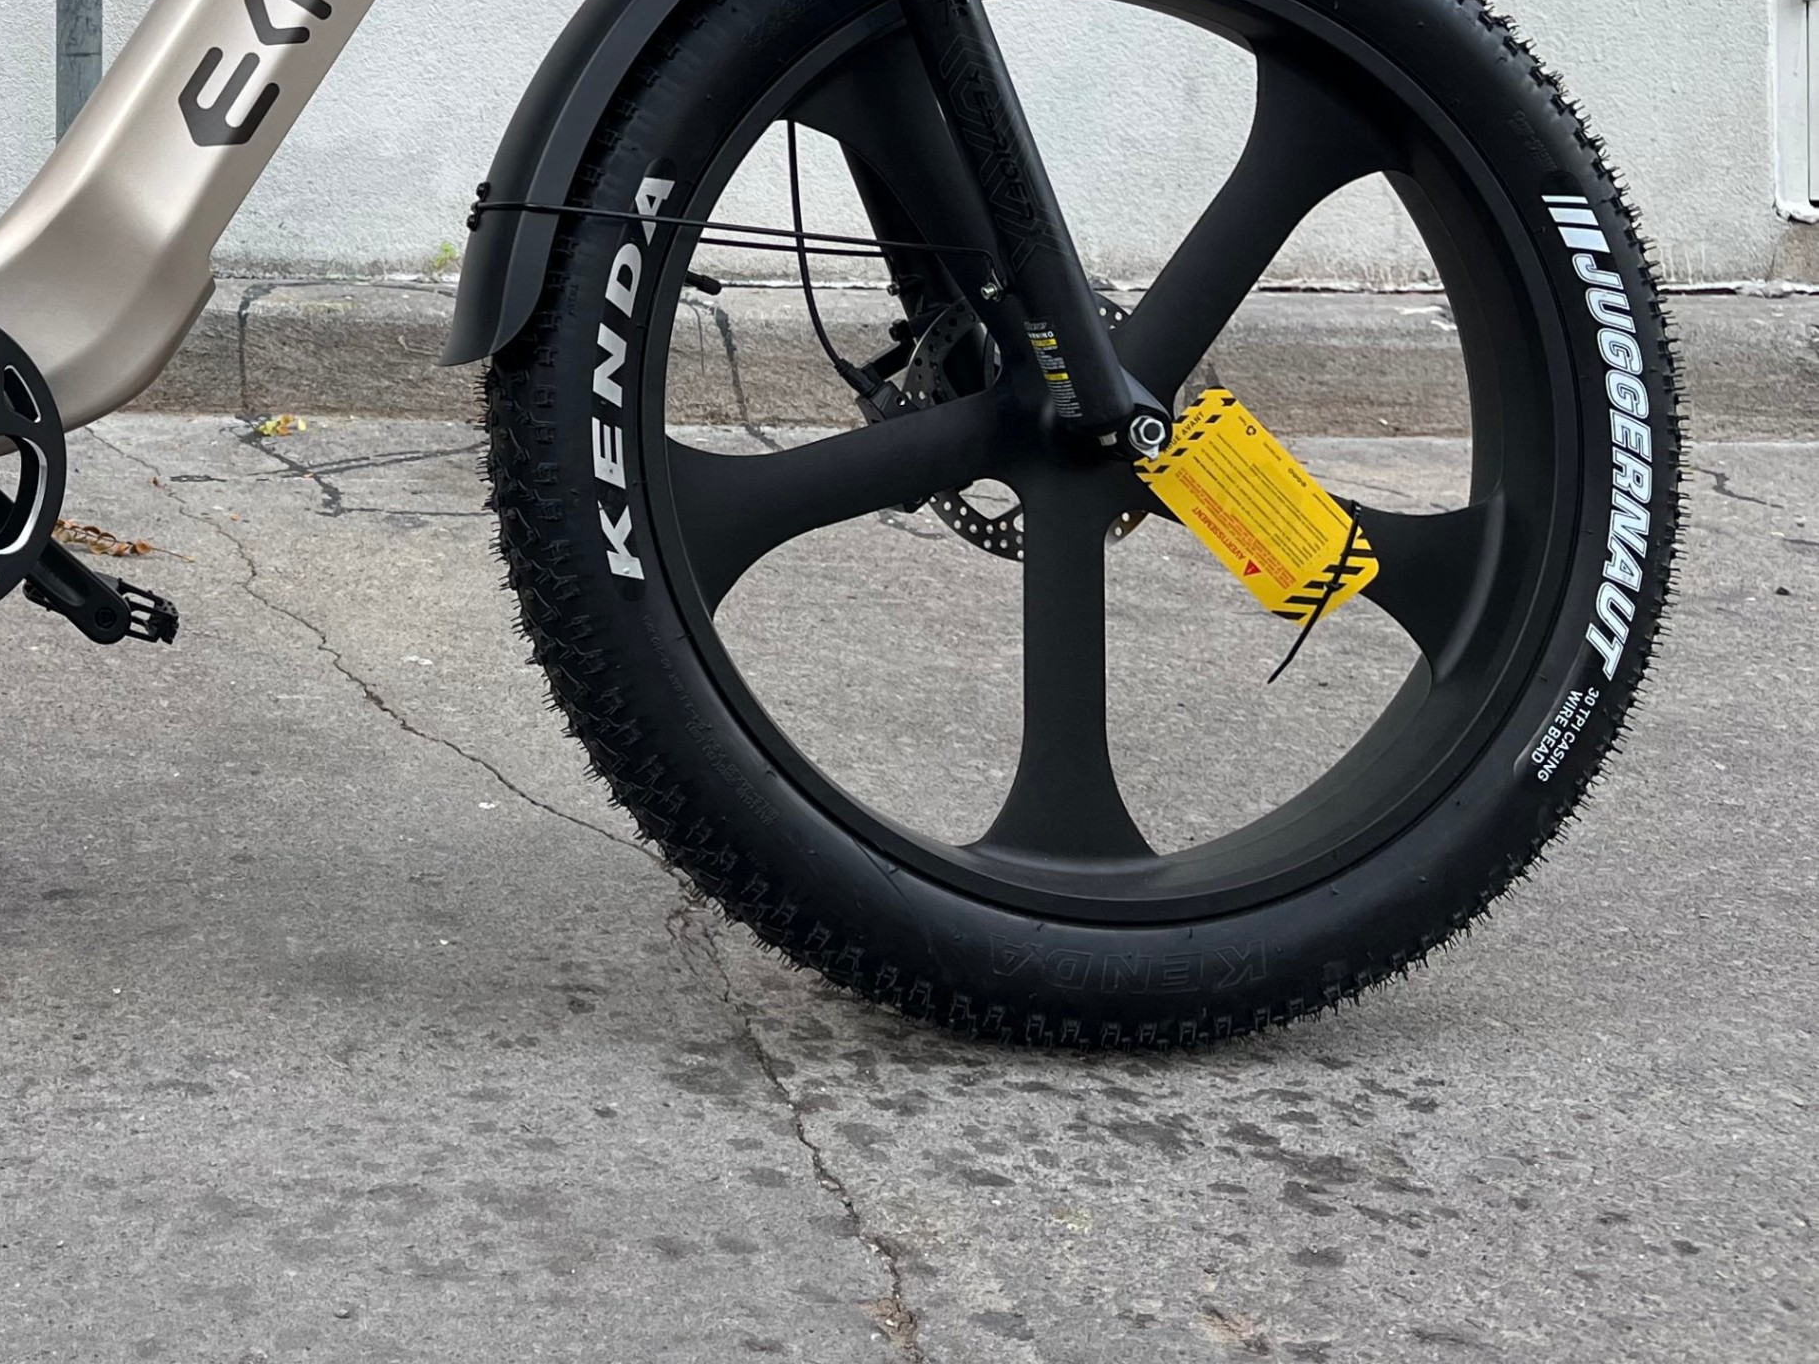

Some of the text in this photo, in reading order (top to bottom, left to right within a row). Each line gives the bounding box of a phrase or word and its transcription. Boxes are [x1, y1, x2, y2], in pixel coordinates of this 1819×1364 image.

[592, 177, 675, 581] KENDA
[1181, 411, 1205, 435] AVANT
[1572, 252, 1653, 681] JUGGERNAUT
[1192, 506, 1246, 560] AVERTISSEMENT
[1531, 690, 1584, 764] WIRE BEAD
[1537, 687, 1600, 782] 30 TPI CASING
[989, 935, 1268, 996] KENDA
